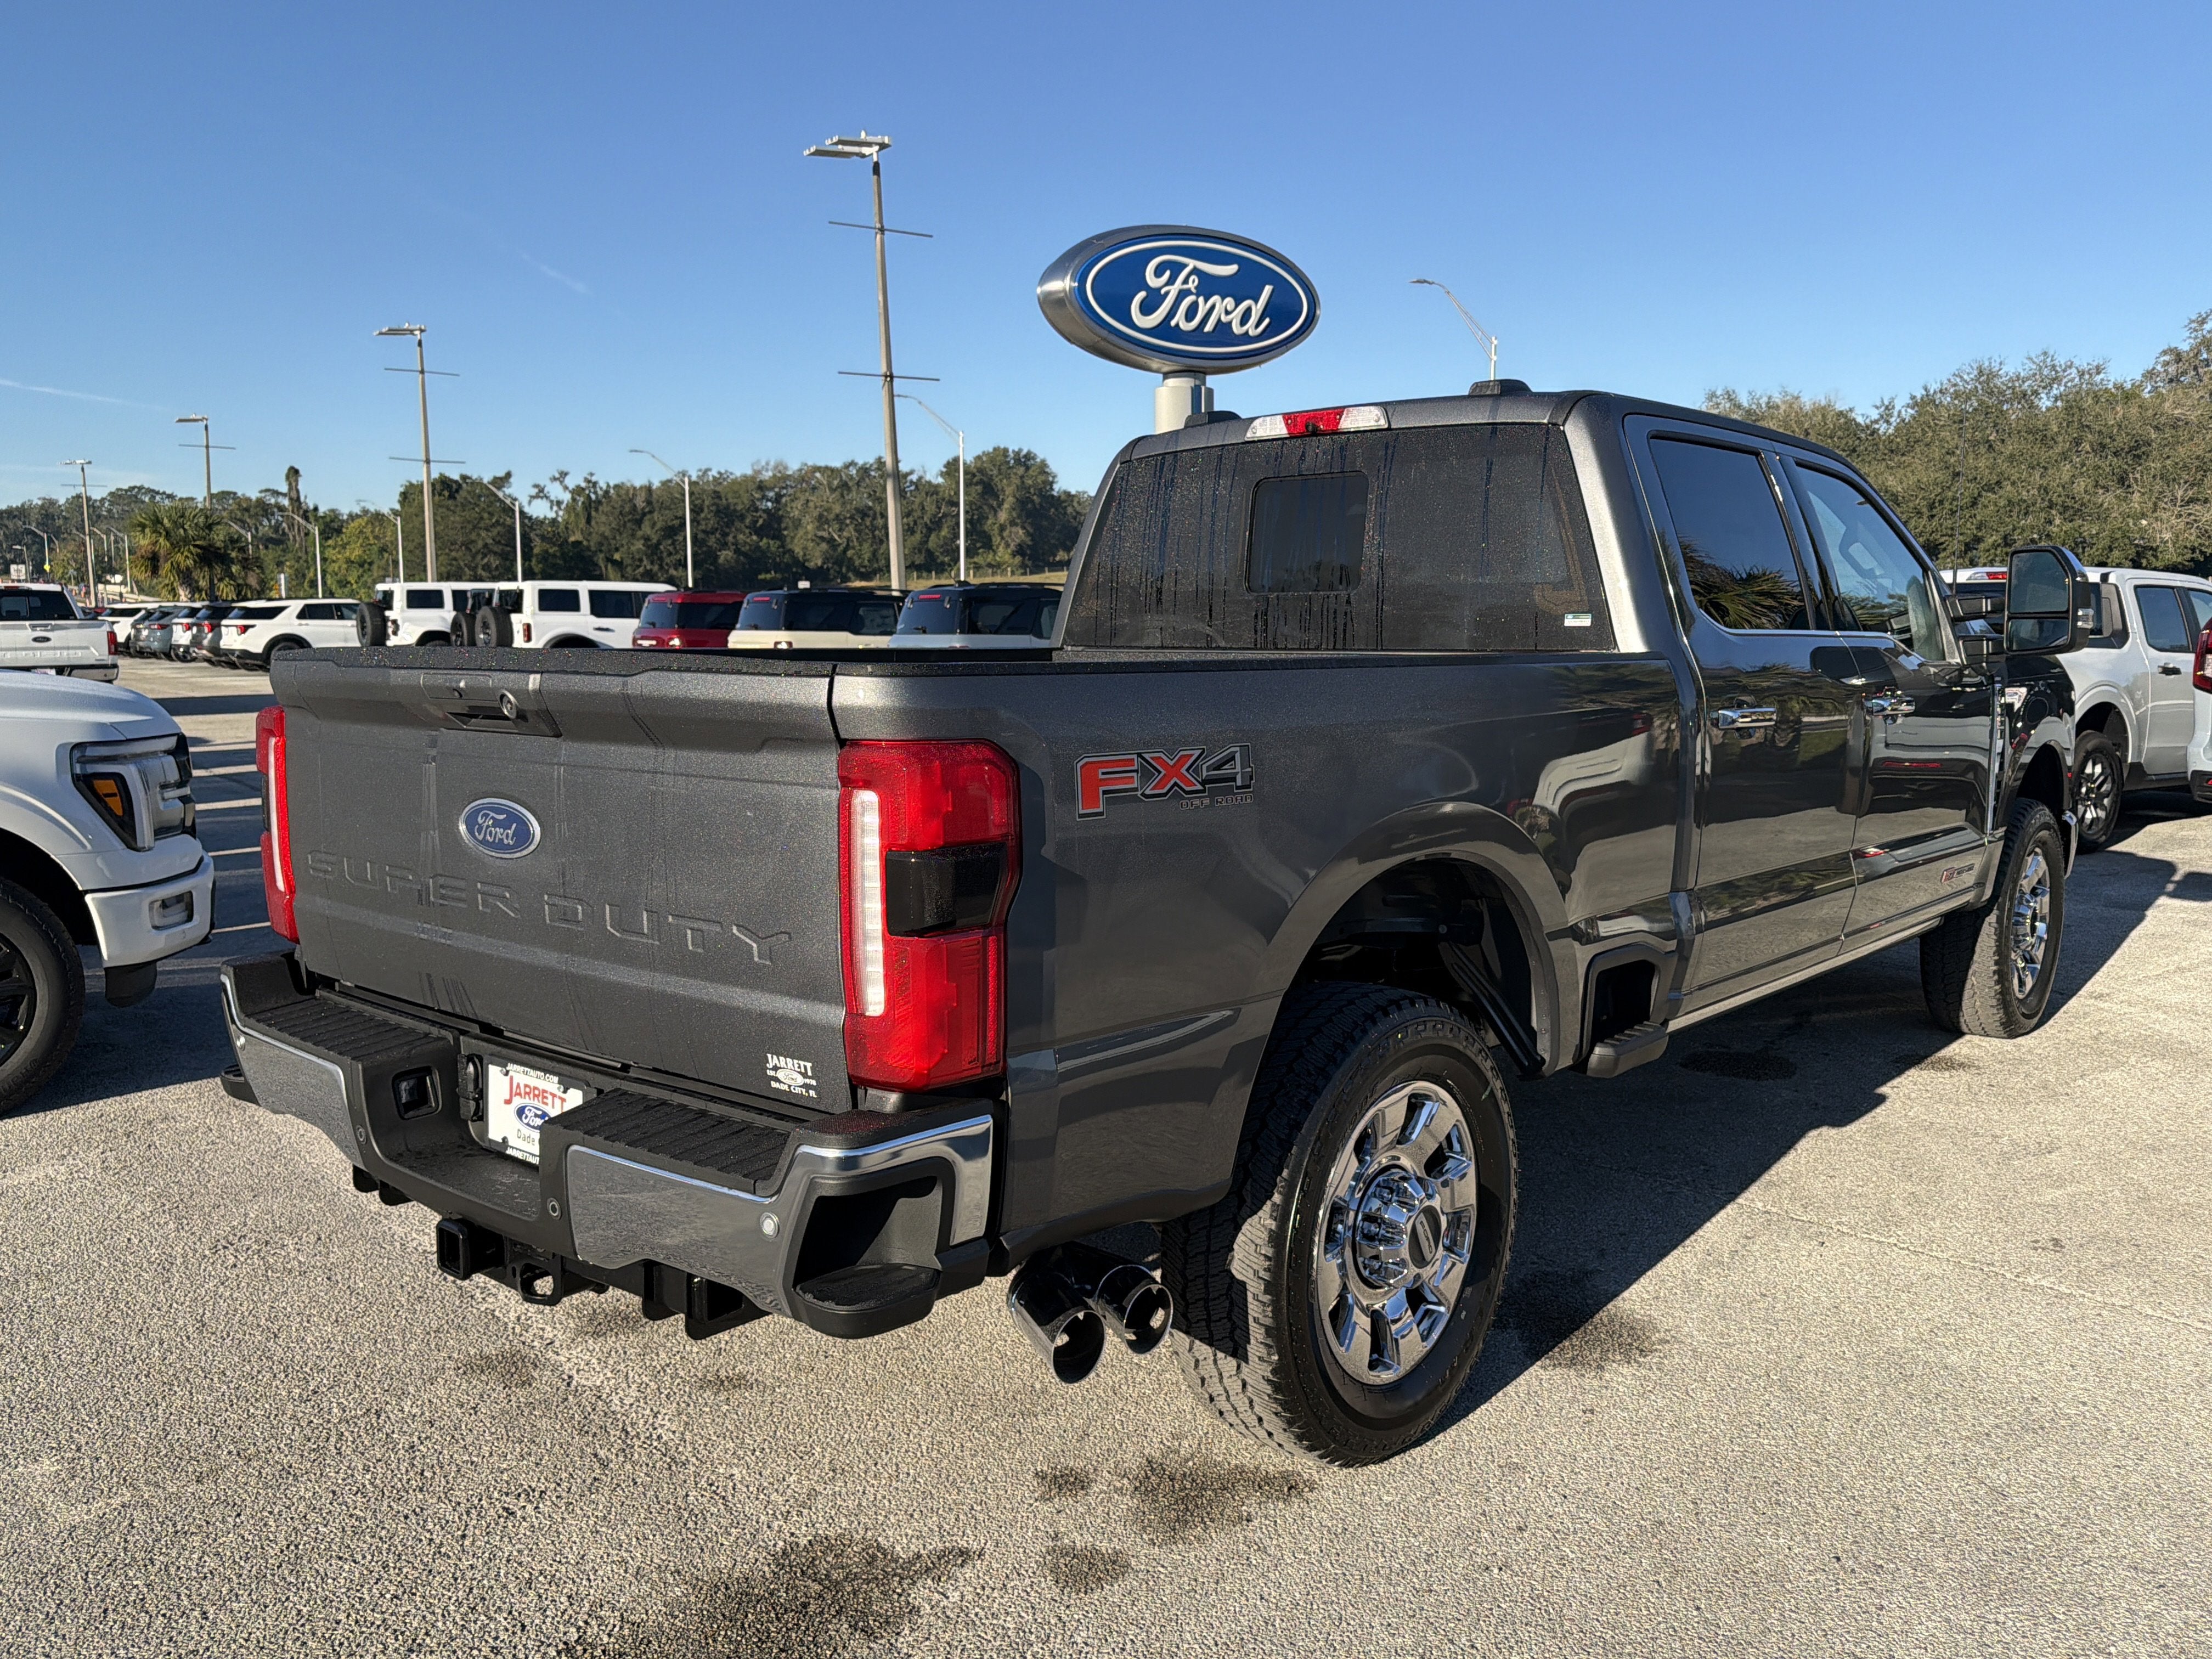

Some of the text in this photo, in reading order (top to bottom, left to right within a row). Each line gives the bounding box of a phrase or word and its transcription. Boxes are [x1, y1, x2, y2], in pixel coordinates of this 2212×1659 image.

[1131, 254, 1273, 336] Ford
[1074, 742, 1255, 821] FX4
[1179, 793, 1254, 810] OFF ROAD
[474, 810, 517, 845] Ford
[308, 850, 792, 965] SUPER DUTY
[506, 1063, 559, 1084] JARRETTAUTO.COM
[766, 1053, 812, 1076] JARRETT
[504, 1075, 567, 1114] JARRETT
[770, 1080, 790, 1092] DADE
[809, 1089, 817, 1098] FL
[522, 1106, 549, 1127] For
[517, 1128, 535, 1146] Dade
